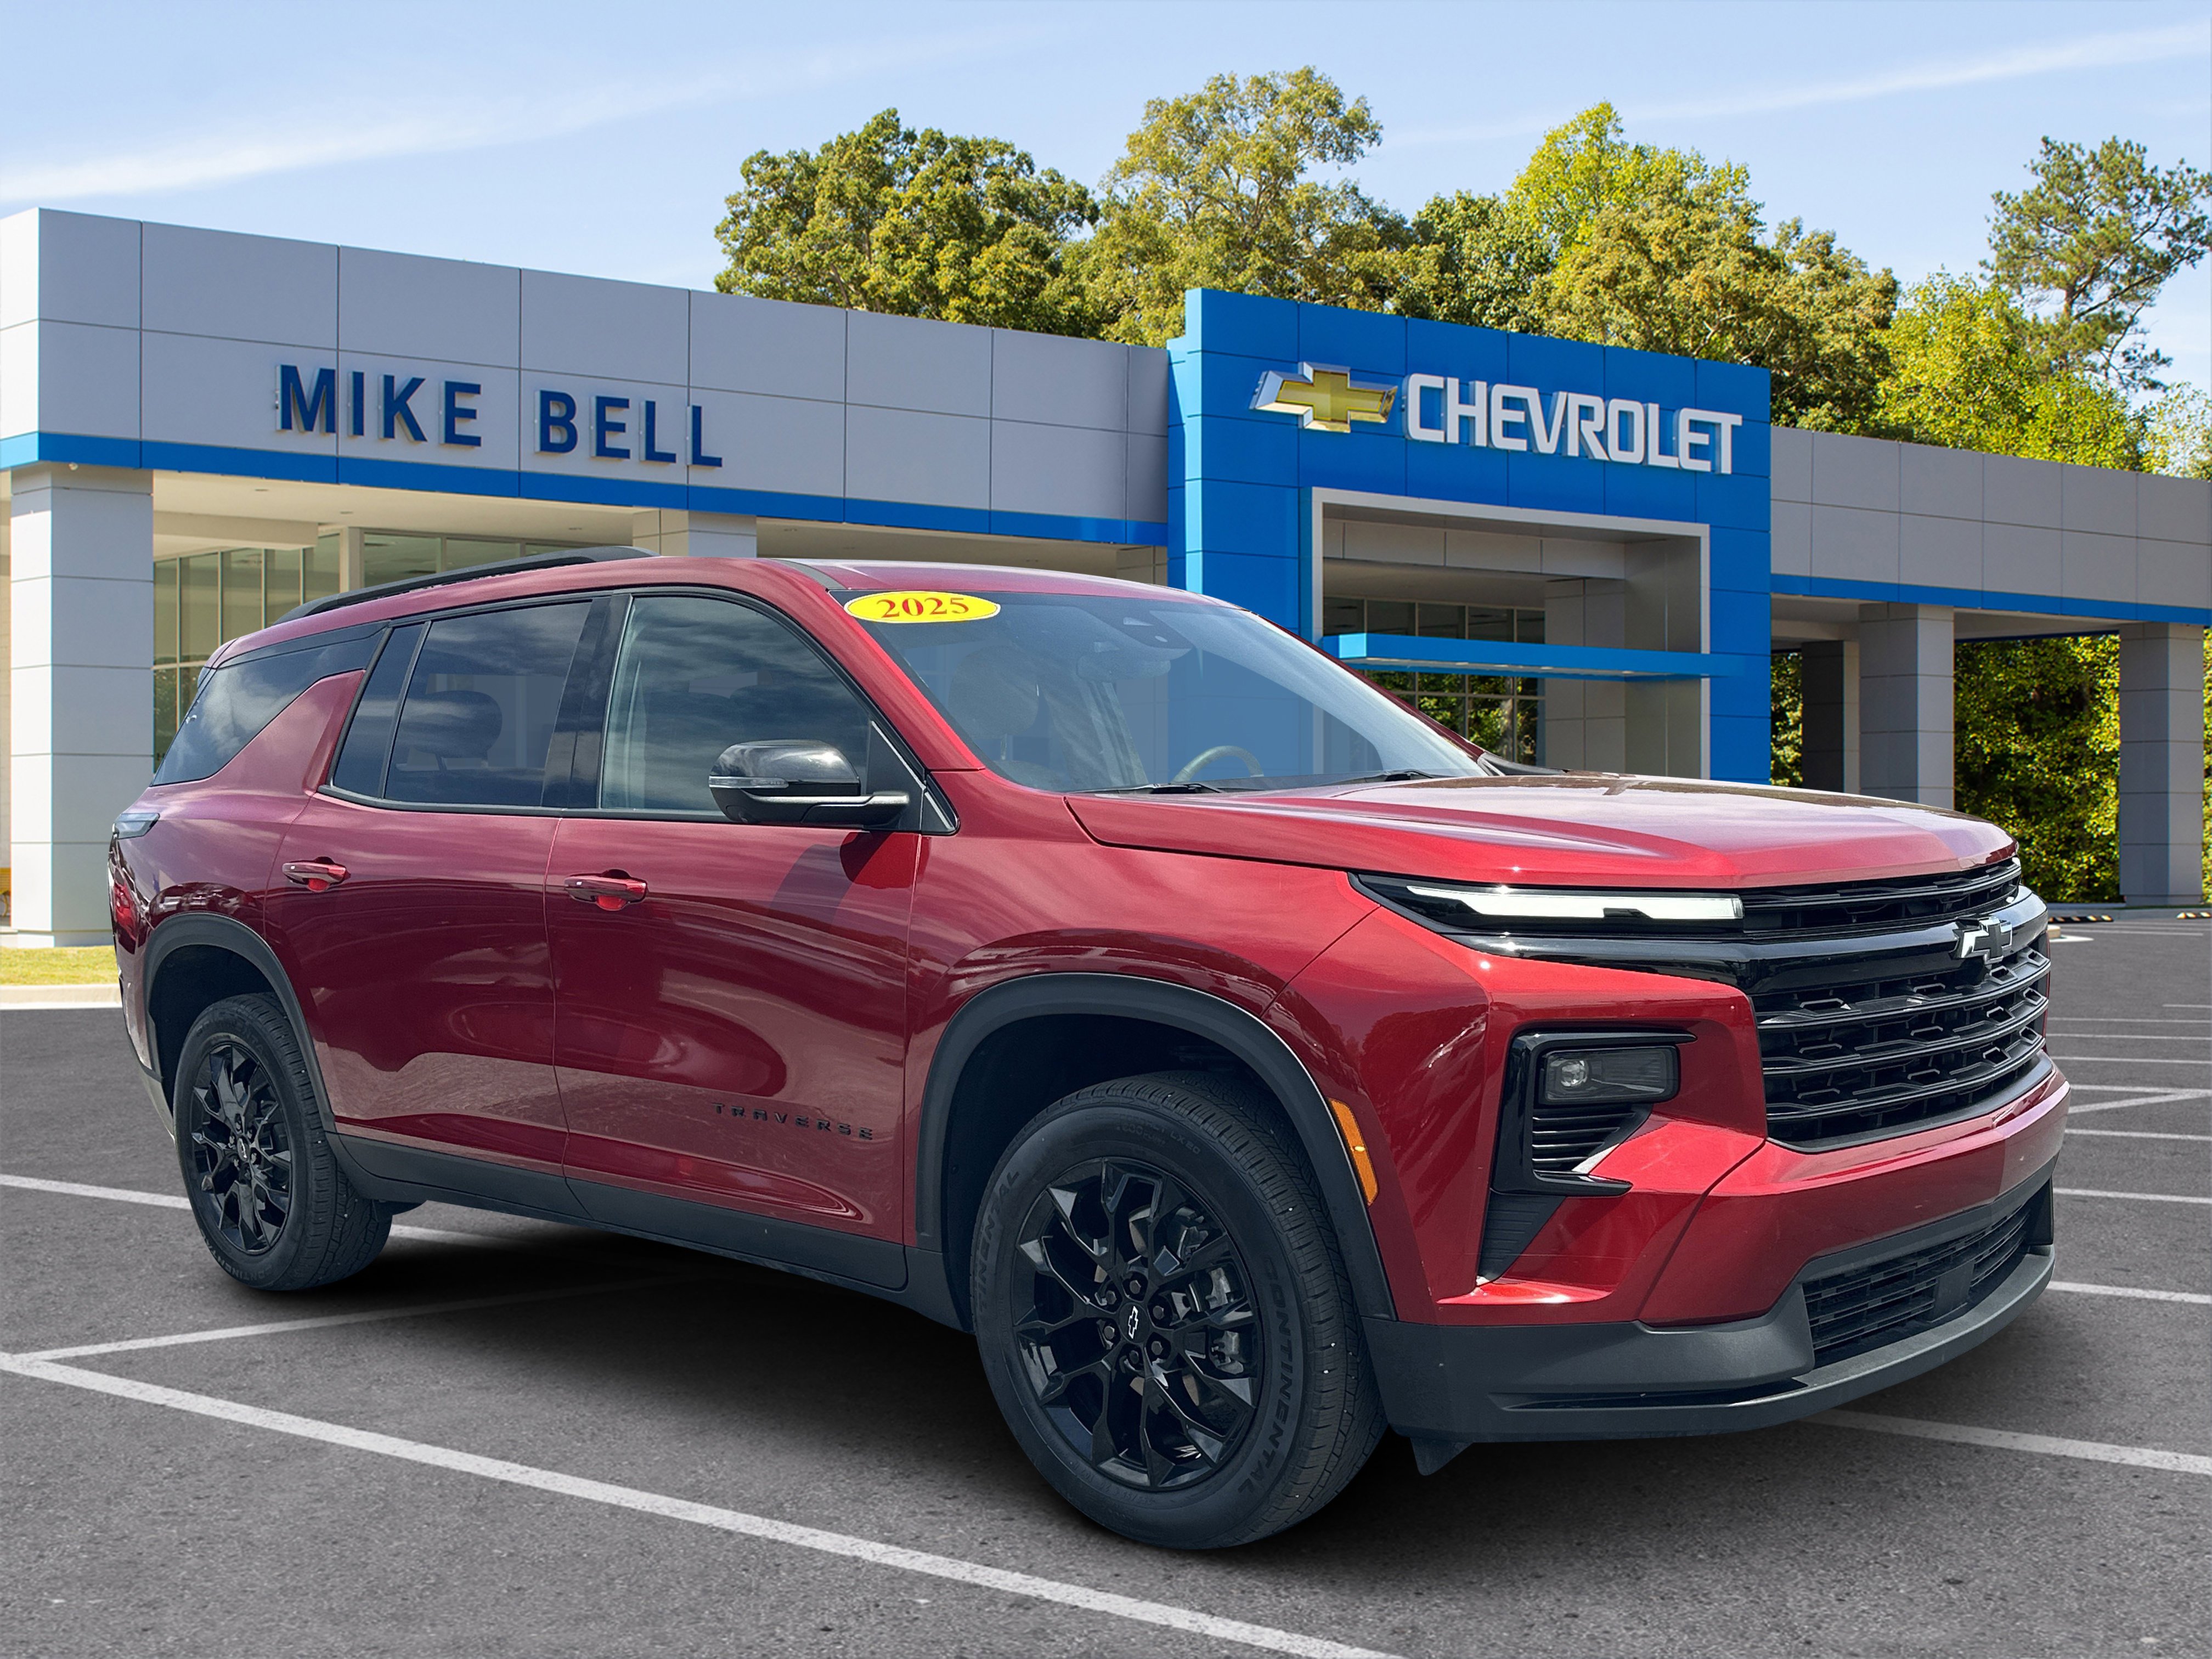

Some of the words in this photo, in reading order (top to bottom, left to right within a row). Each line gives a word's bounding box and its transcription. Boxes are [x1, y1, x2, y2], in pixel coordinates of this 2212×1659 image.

[276, 364, 482, 447] MIKE
[534, 389, 723, 468] BELL
[1403, 373, 1743, 475] CHEVROLET
[876, 597, 969, 618] 2025
[711, 1102, 873, 1141] TRAVERSE
[1238, 1259, 1293, 1494] CONTINENTAL
